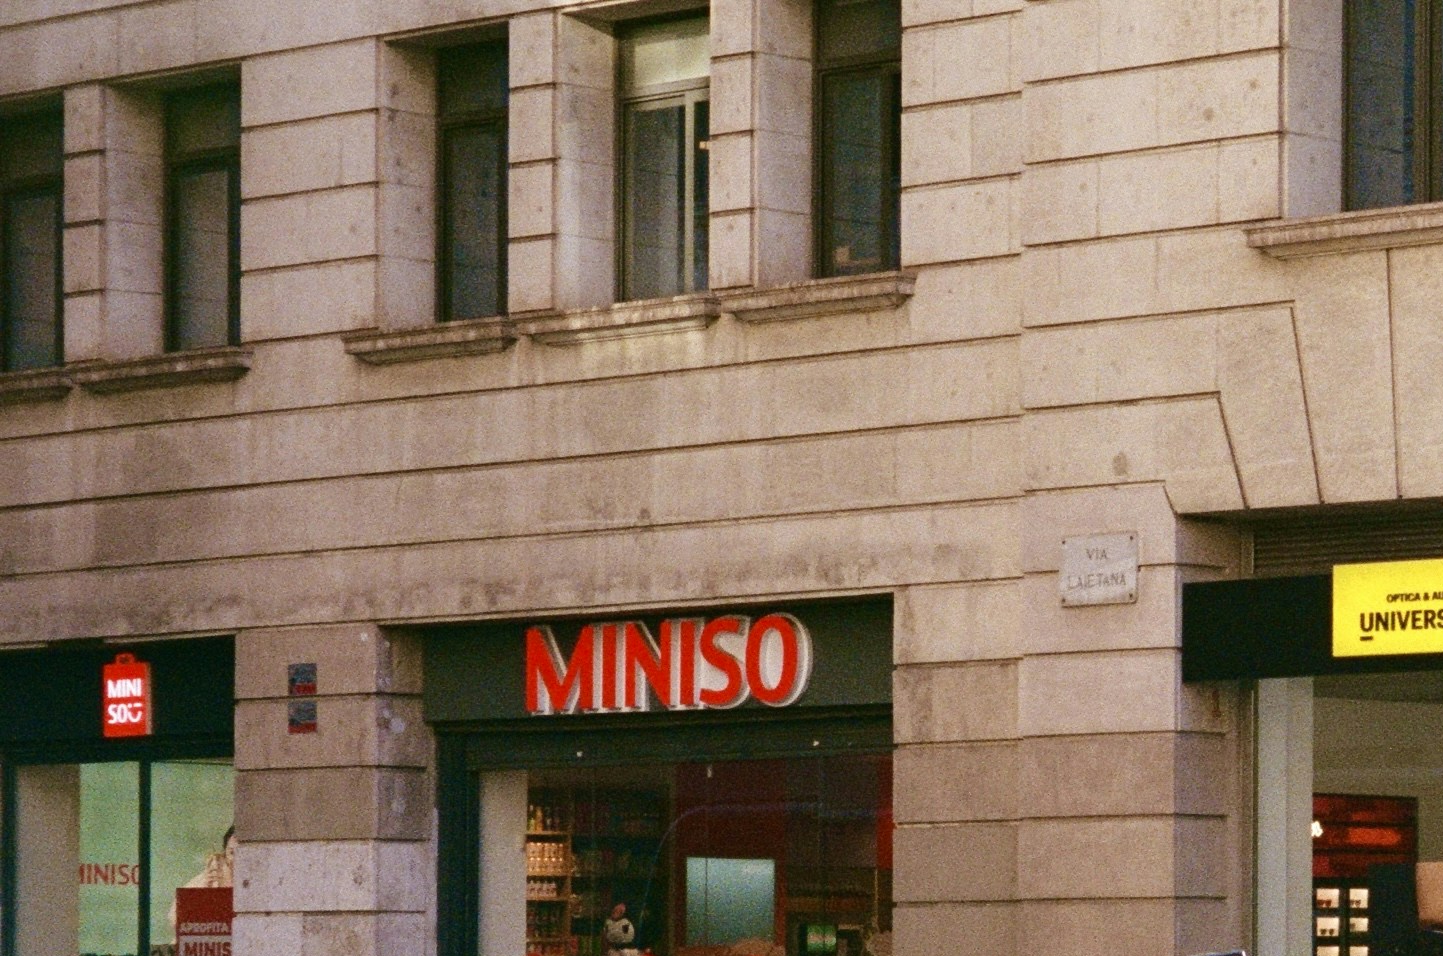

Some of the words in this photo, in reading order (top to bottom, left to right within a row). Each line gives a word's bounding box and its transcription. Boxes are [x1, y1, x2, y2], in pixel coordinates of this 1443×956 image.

[1423, 592, 1430, 601] &
[524, 612, 814, 716] MINISO
[107, 678, 142, 698] MINI
